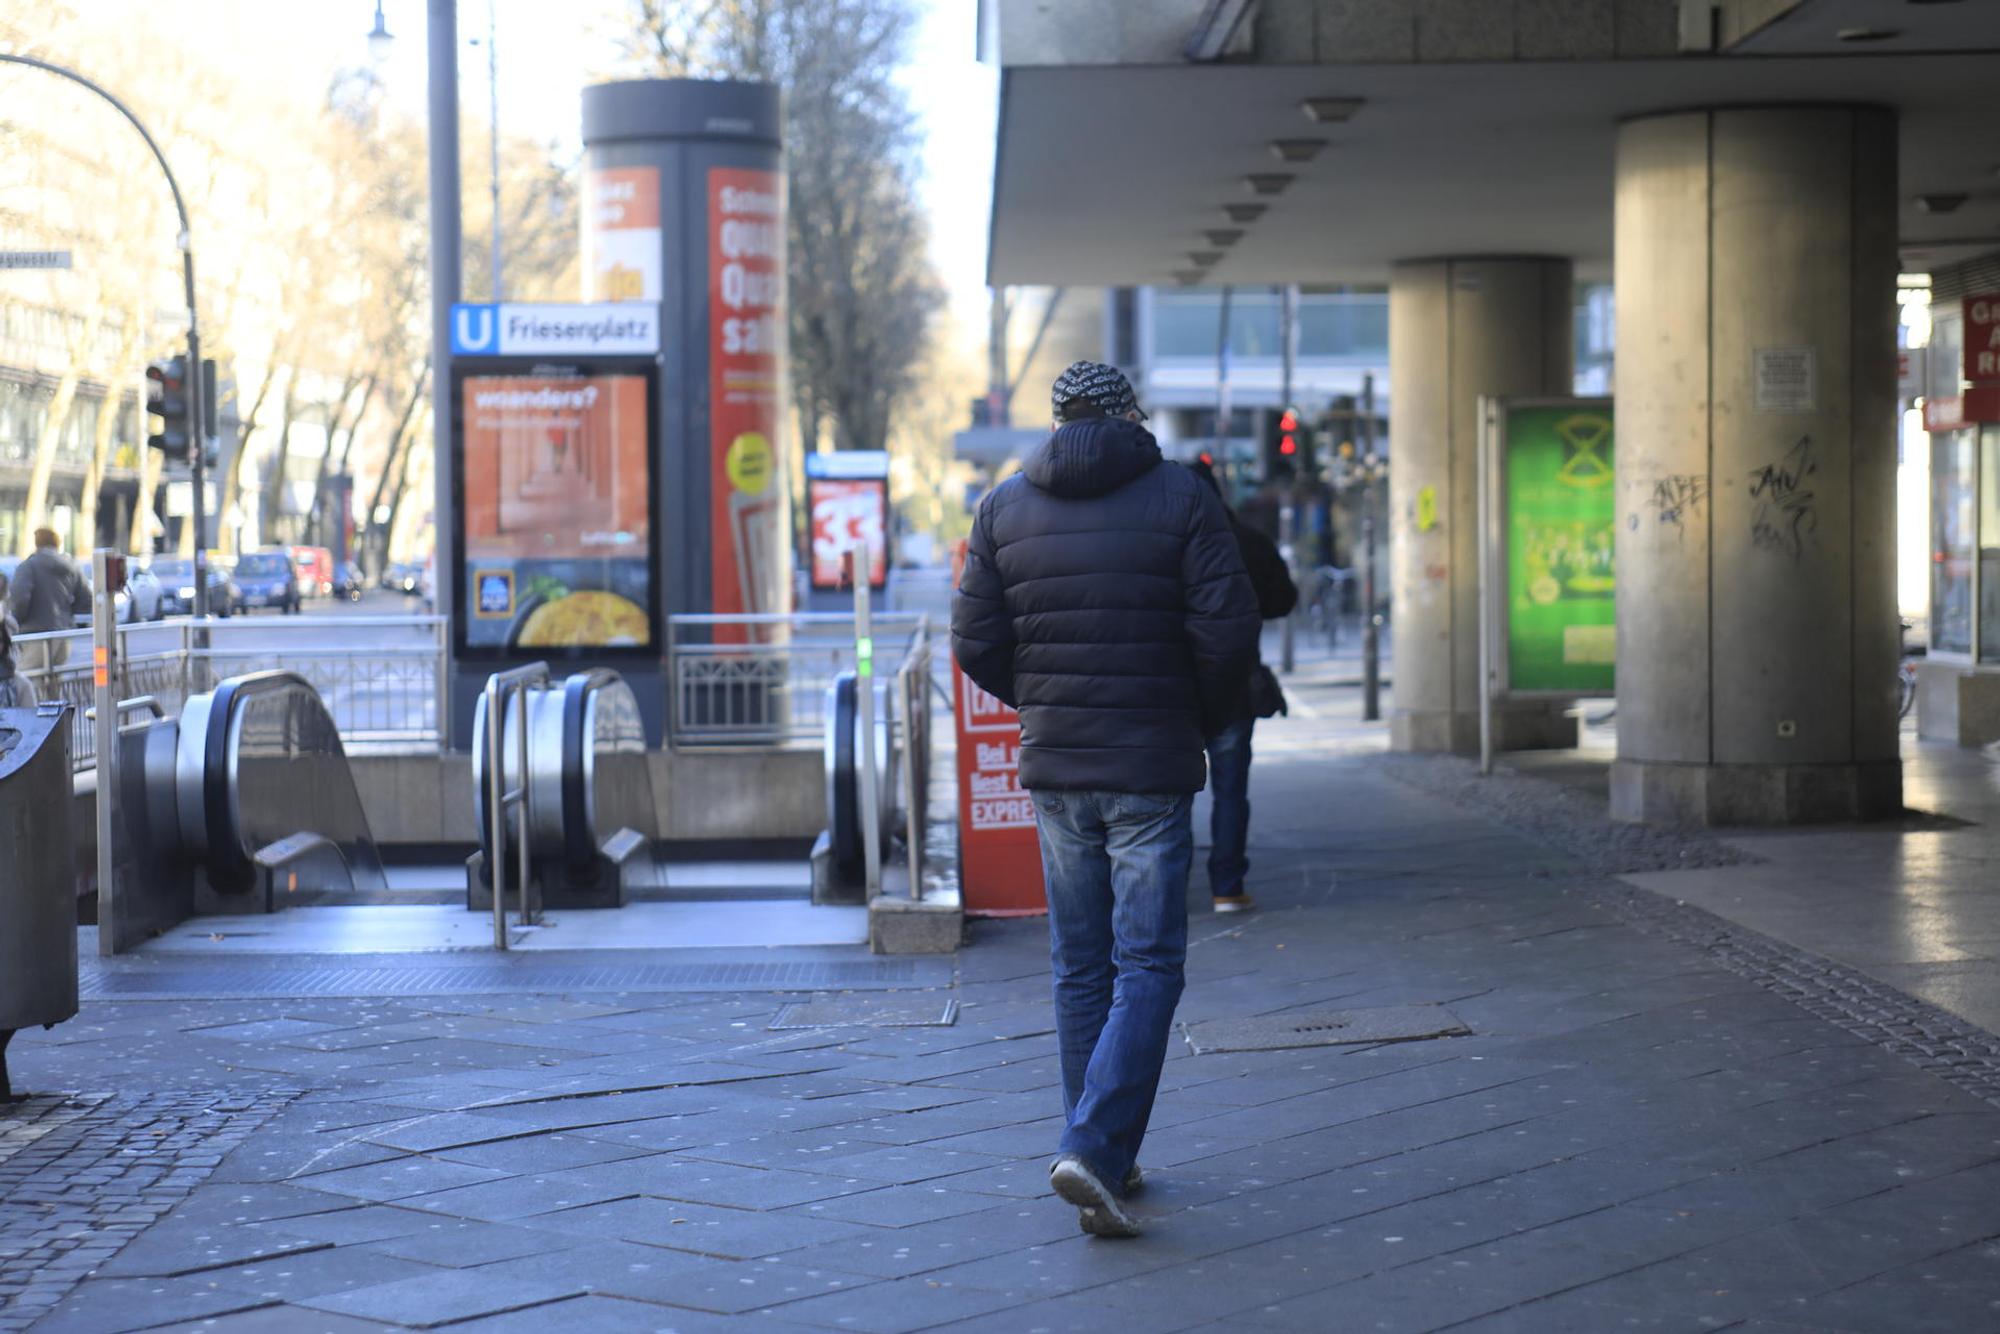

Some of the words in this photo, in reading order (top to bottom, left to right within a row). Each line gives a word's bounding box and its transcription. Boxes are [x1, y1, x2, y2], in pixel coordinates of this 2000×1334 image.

[456, 308, 492, 350] U
[508, 315, 649, 344] Friesenplatz
[976, 741, 1007, 763] Bei
